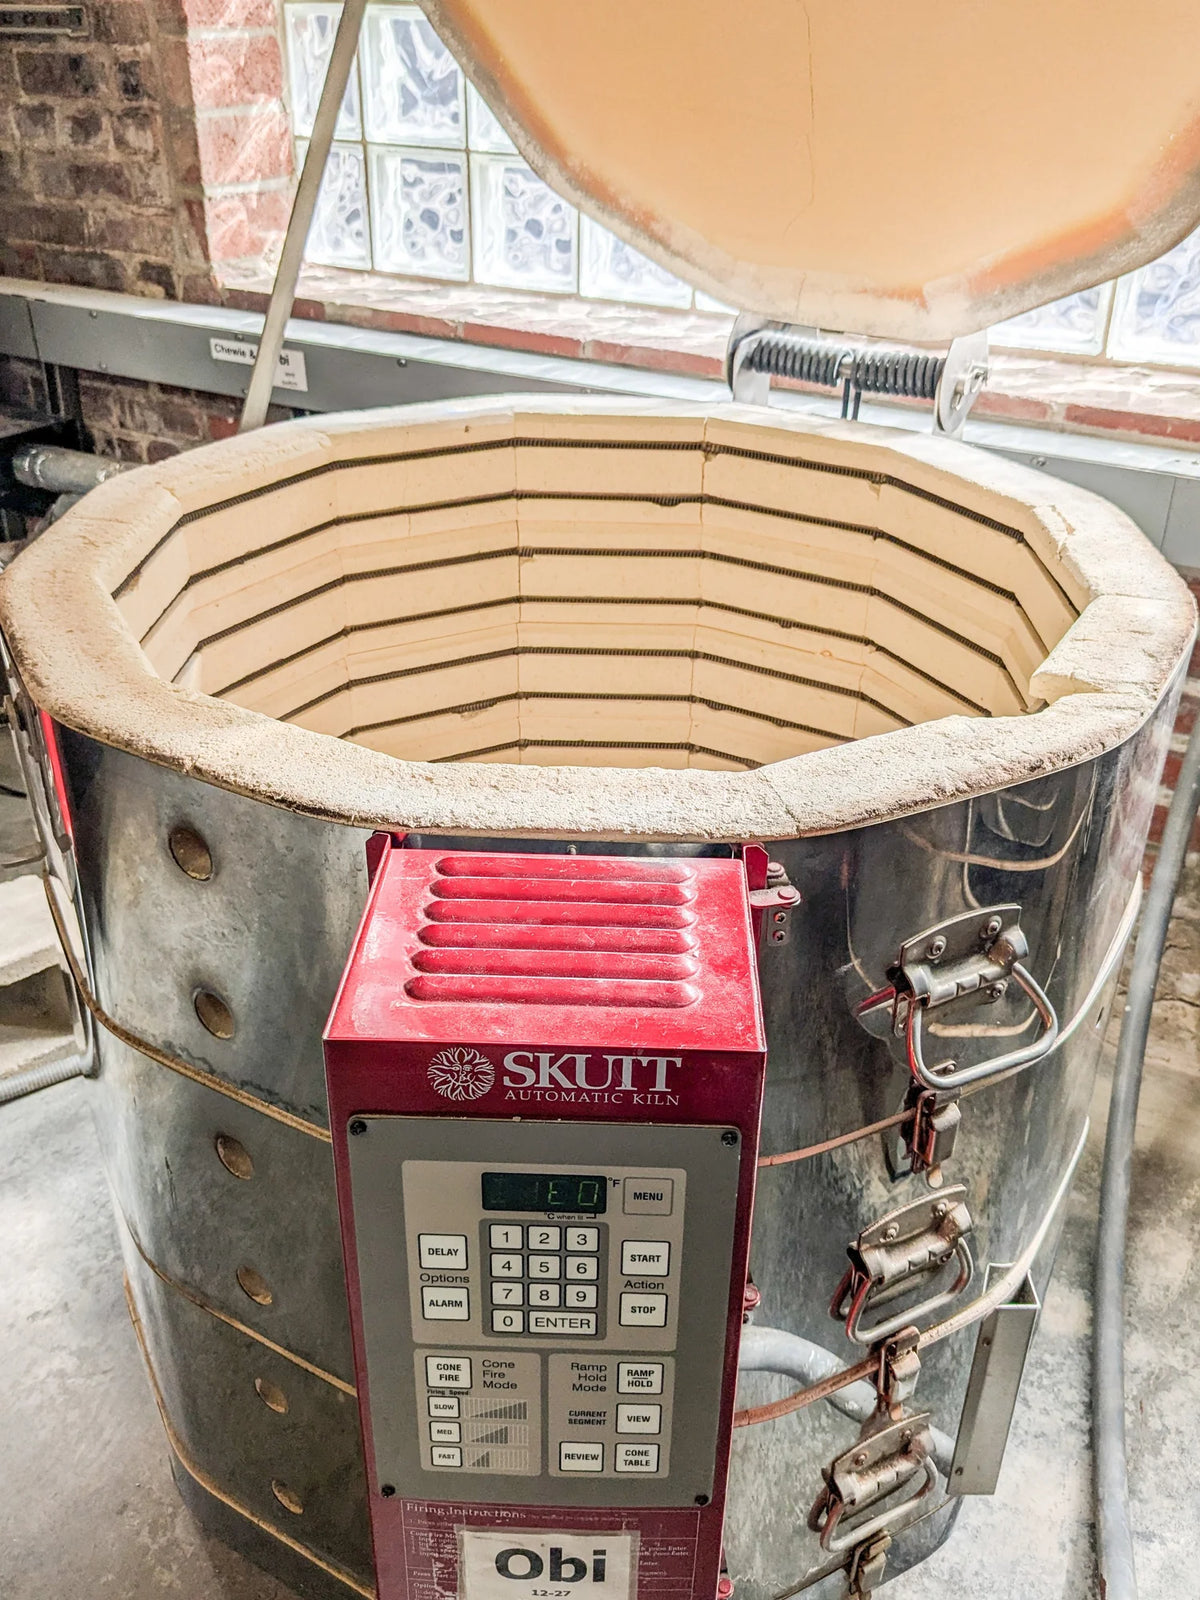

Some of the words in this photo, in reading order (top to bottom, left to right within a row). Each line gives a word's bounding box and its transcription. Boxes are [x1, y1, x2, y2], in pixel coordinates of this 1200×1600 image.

[503, 1051, 682, 1092] SKUTT
[504, 1090, 623, 1104] AUTOMATIC
[633, 1093, 680, 1106] KILN
[633, 1192, 663, 1201] MENU
[502, 1231, 509, 1243] 1
[539, 1232, 550, 1244] 2
[577, 1233, 587, 1245] 3
[428, 1247, 459, 1256] DELAY
[630, 1254, 661, 1263] START
[502, 1260, 512, 1272] 4
[539, 1261, 549, 1273] 5
[577, 1262, 587, 1274] 6
[419, 1273, 470, 1284] Options
[624, 1280, 664, 1290] Action
[502, 1288, 513, 1300] 7
[539, 1289, 549, 1301] 8
[576, 1291, 586, 1302] 9
[429, 1299, 463, 1308] ALARM
[631, 1305, 656, 1314] STOP
[503, 1315, 513, 1327] 0
[535, 1316, 591, 1329] ENTER
[436, 1363, 462, 1371] CONE
[482, 1359, 515, 1369] Cone
[571, 1362, 607, 1373] Ramp
[439, 1374, 460, 1382] FIRE
[482, 1370, 506, 1379] Fire
[578, 1373, 607, 1382] Hold
[627, 1369, 655, 1377] RAMP
[483, 1380, 518, 1390] Mode
[572, 1383, 607, 1392] Mode
[627, 1380, 653, 1388] HOLD
[627, 1415, 651, 1423] VIEW
[625, 1449, 650, 1457] CONE
[406, 1502, 447, 1516] Firing
[450, 1507, 526, 1519] Instructions
[494, 1547, 606, 1583] Obi
[531, 1589, 572, 1597] 12-27
